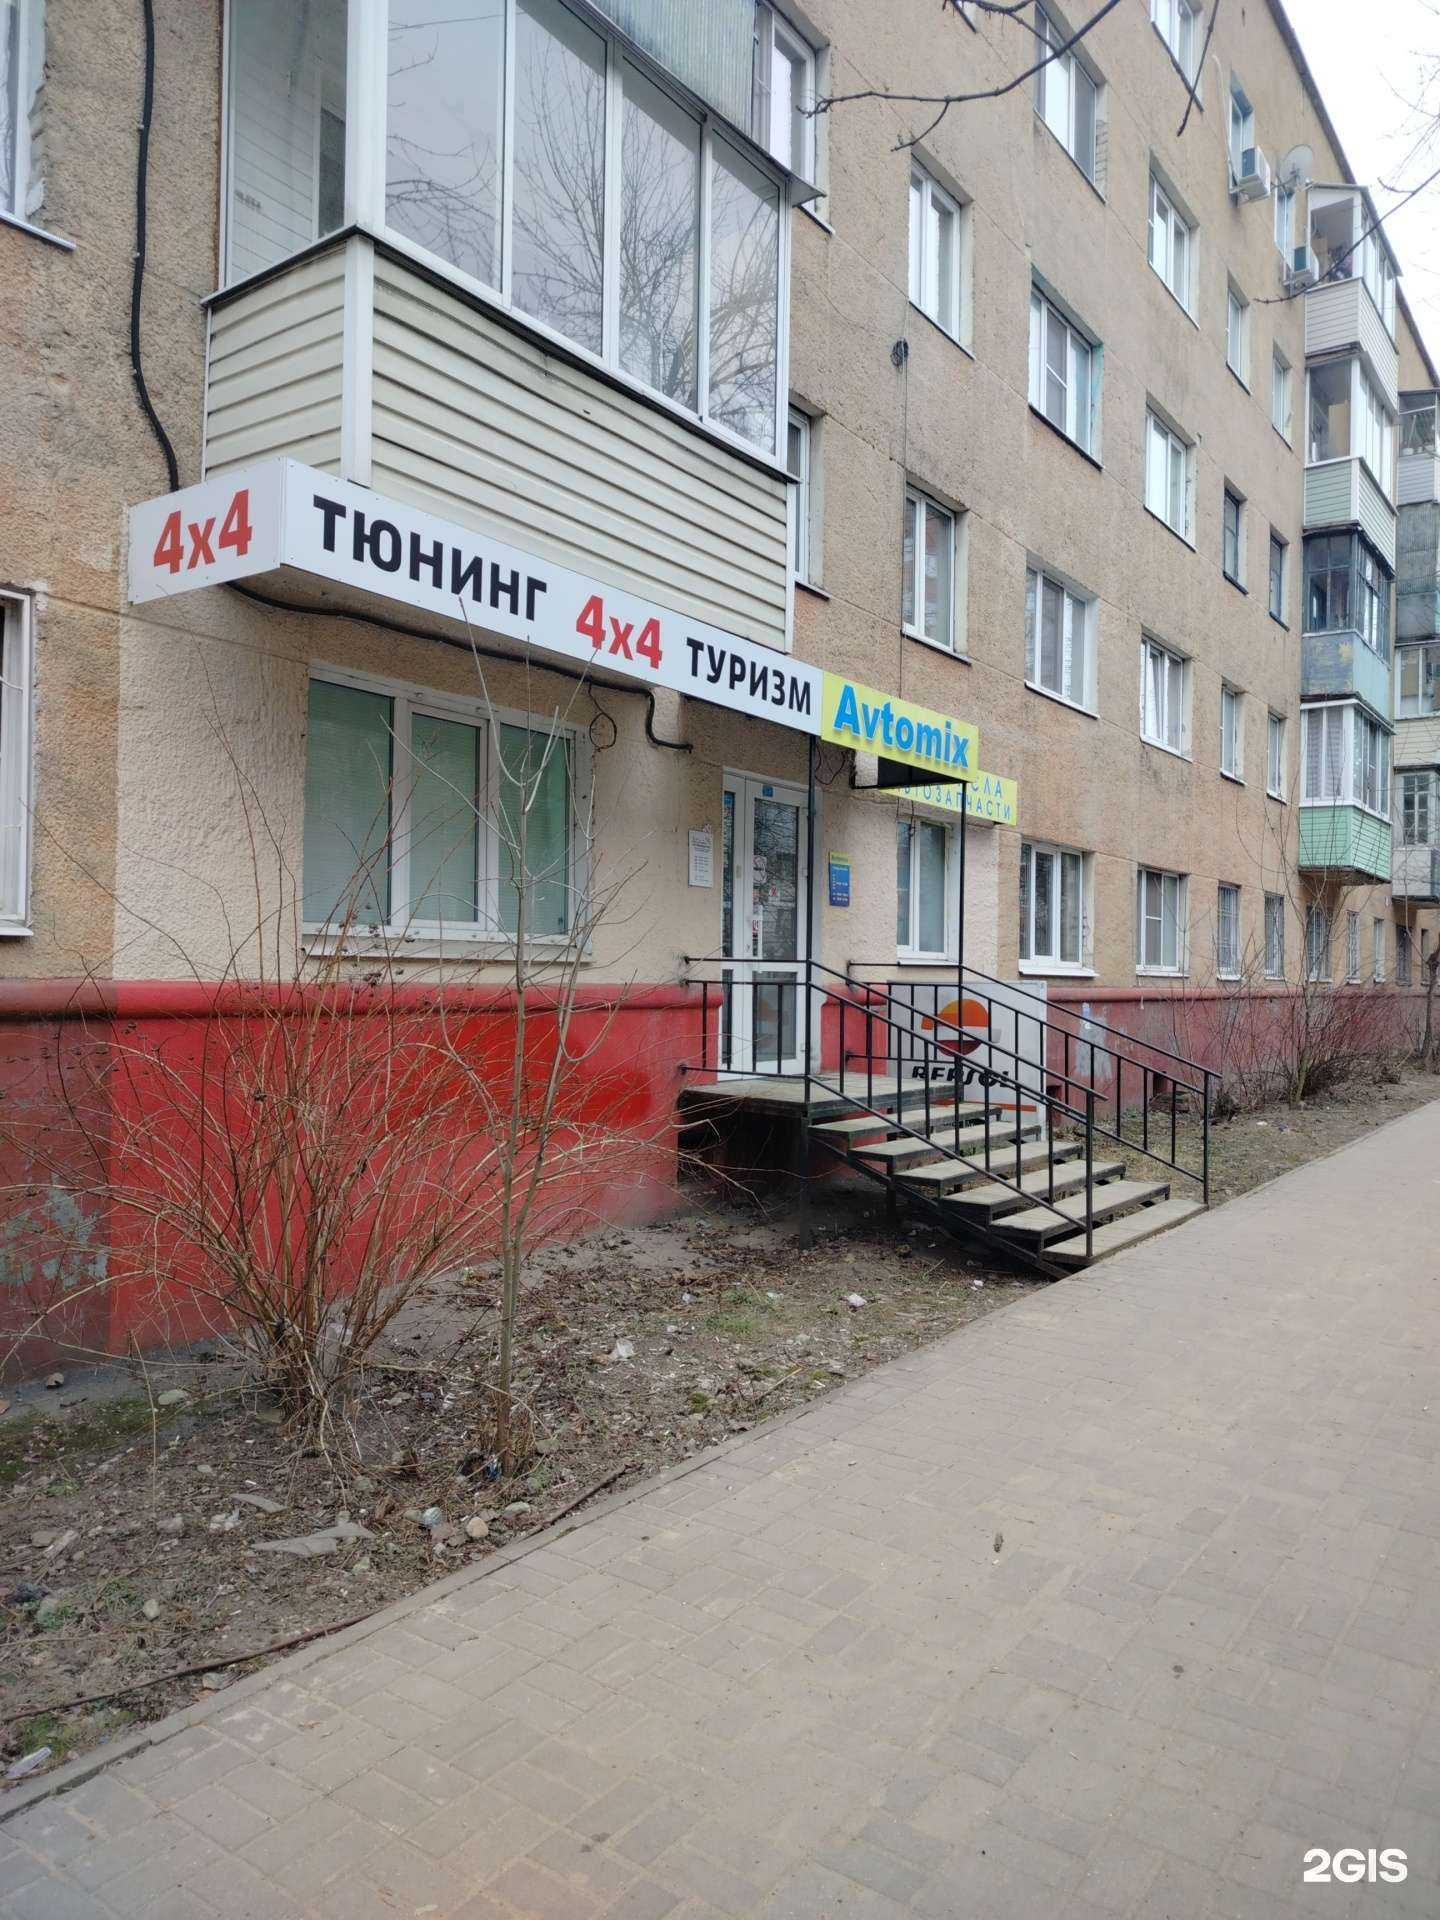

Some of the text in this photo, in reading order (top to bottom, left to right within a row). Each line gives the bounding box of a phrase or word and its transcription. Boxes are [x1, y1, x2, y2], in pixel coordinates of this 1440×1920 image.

[313, 495, 547, 621] ТЮНИНГ
[686, 637, 811, 716] ТУРИЗМ
[833, 684, 970, 769] Avtomix
[897, 783, 1011, 821] ОЗАПЧАСТИ
